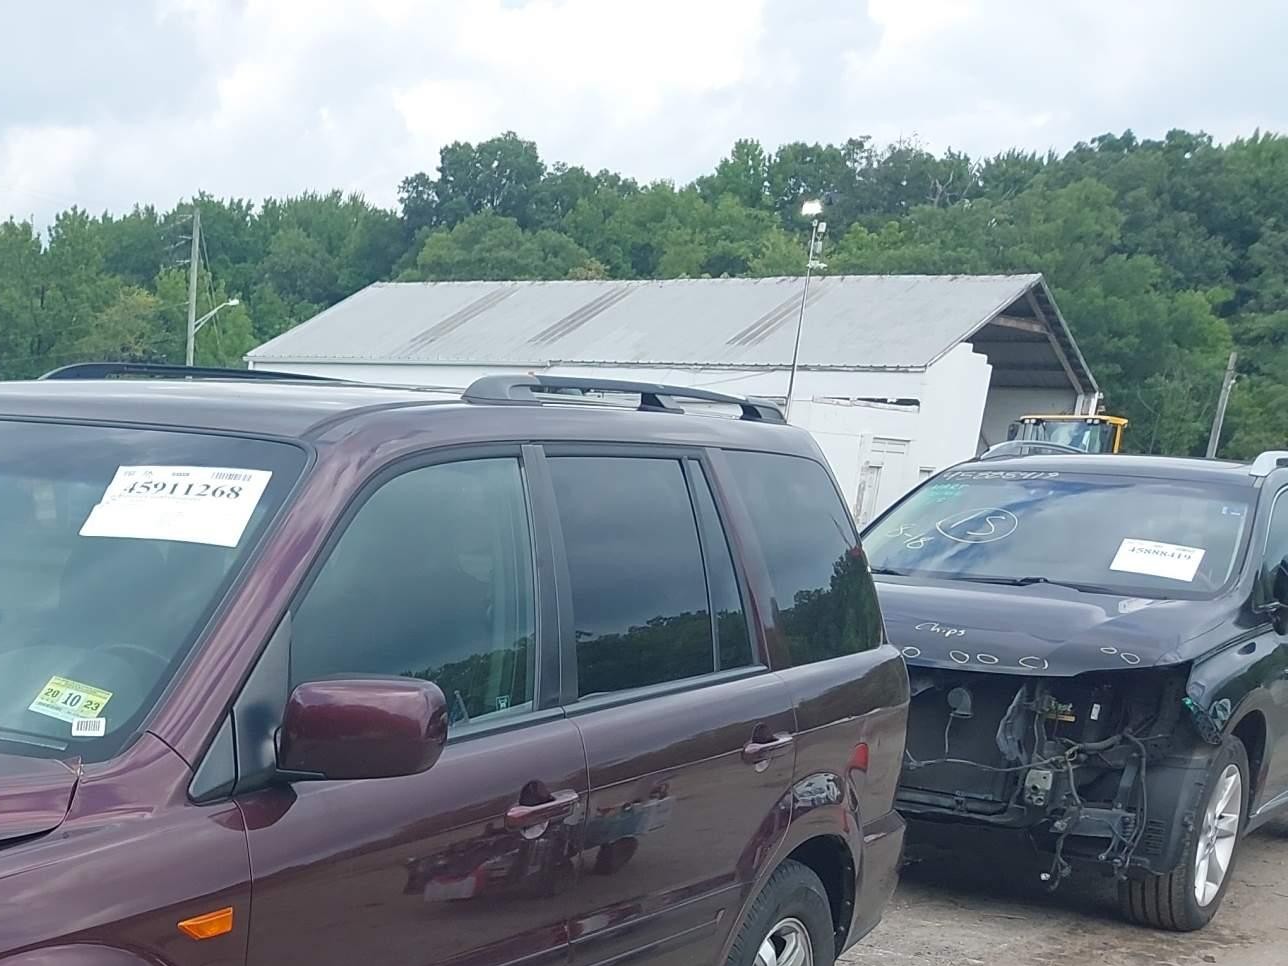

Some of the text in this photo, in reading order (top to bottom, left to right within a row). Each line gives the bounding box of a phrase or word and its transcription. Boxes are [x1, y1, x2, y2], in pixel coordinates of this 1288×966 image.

[123, 480, 243, 500] 45911268
[915, 622, 966, 637] Chips
[44, 687, 60, 698] 20
[62, 692, 82, 707] 10
[84, 700, 100, 711] 23
